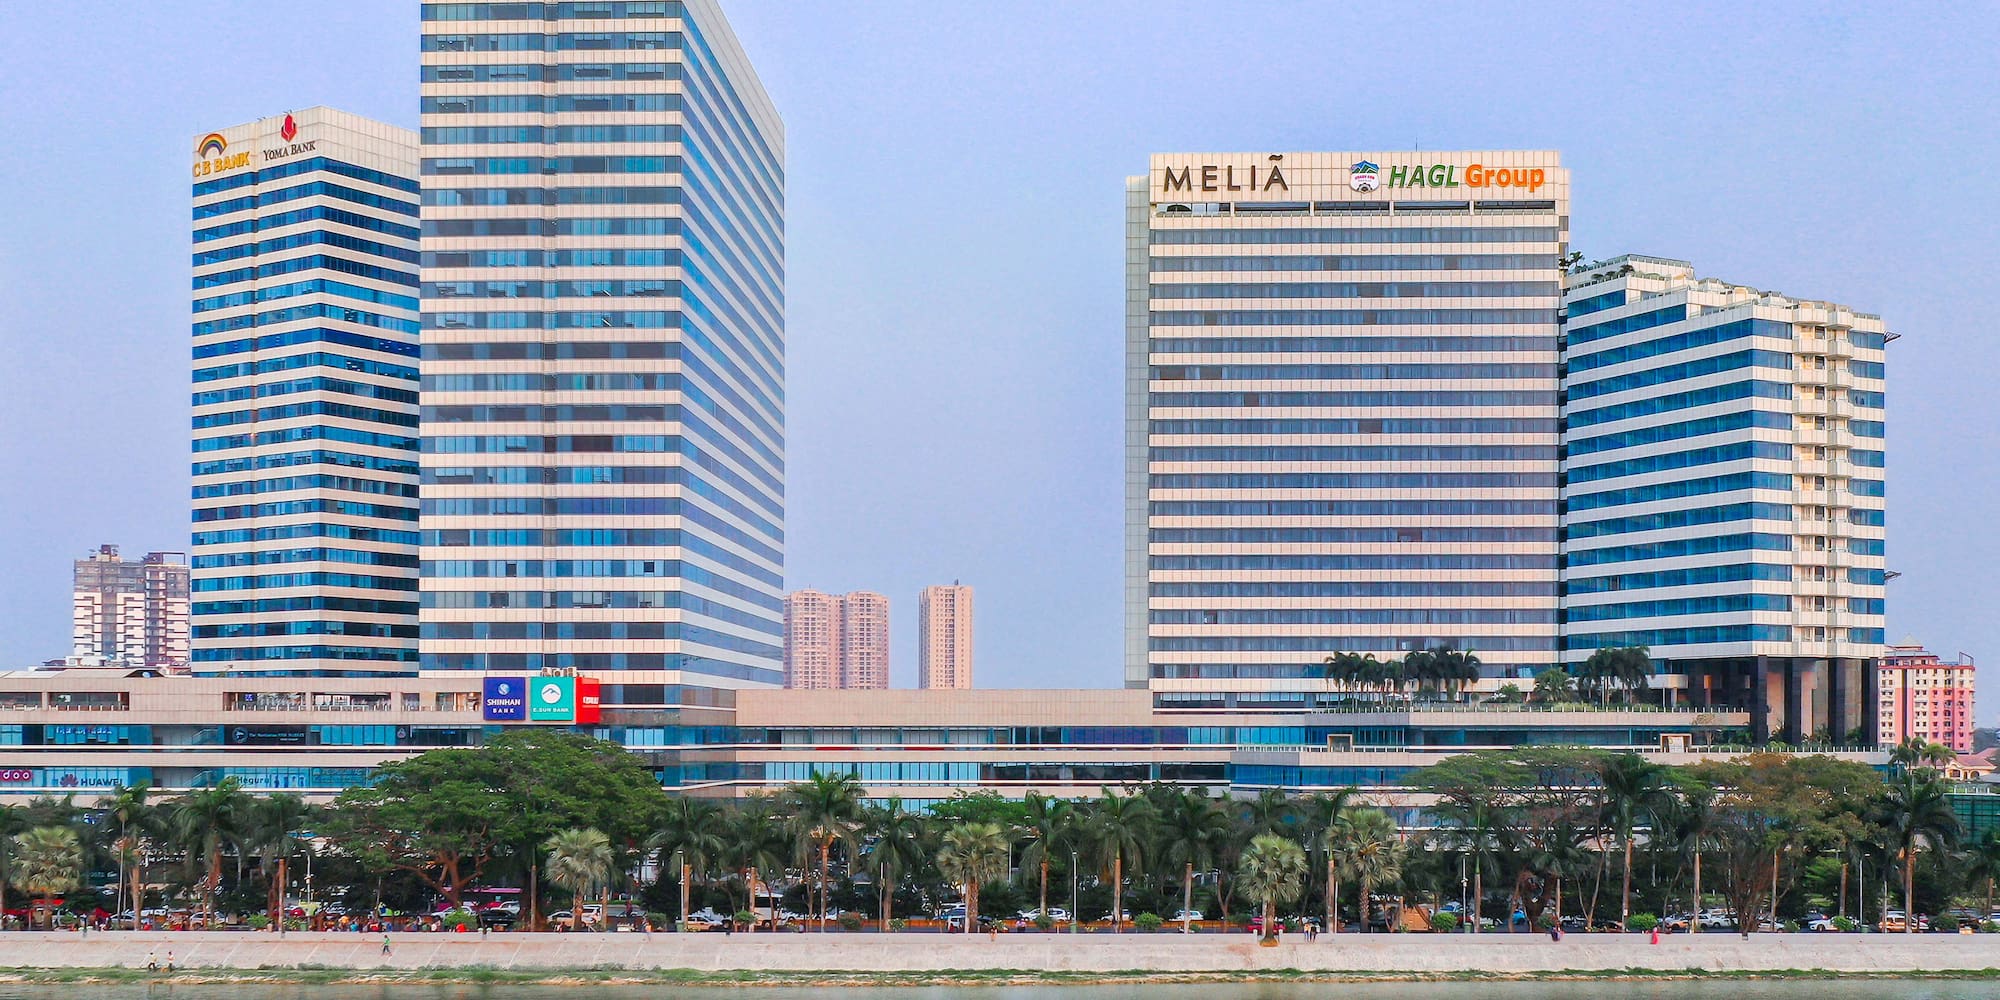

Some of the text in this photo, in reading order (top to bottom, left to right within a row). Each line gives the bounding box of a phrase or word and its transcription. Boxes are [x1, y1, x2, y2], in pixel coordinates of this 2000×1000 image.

[263, 140, 316, 161] YOMA BANK
[192, 151, 250, 178] CB BANK
[1163, 154, 1288, 192] MELIÃ
[1388, 163, 1545, 193] HAGL Group
[487, 698, 521, 706] SHINHAN
[80, 778, 123, 787] HUAWEI
